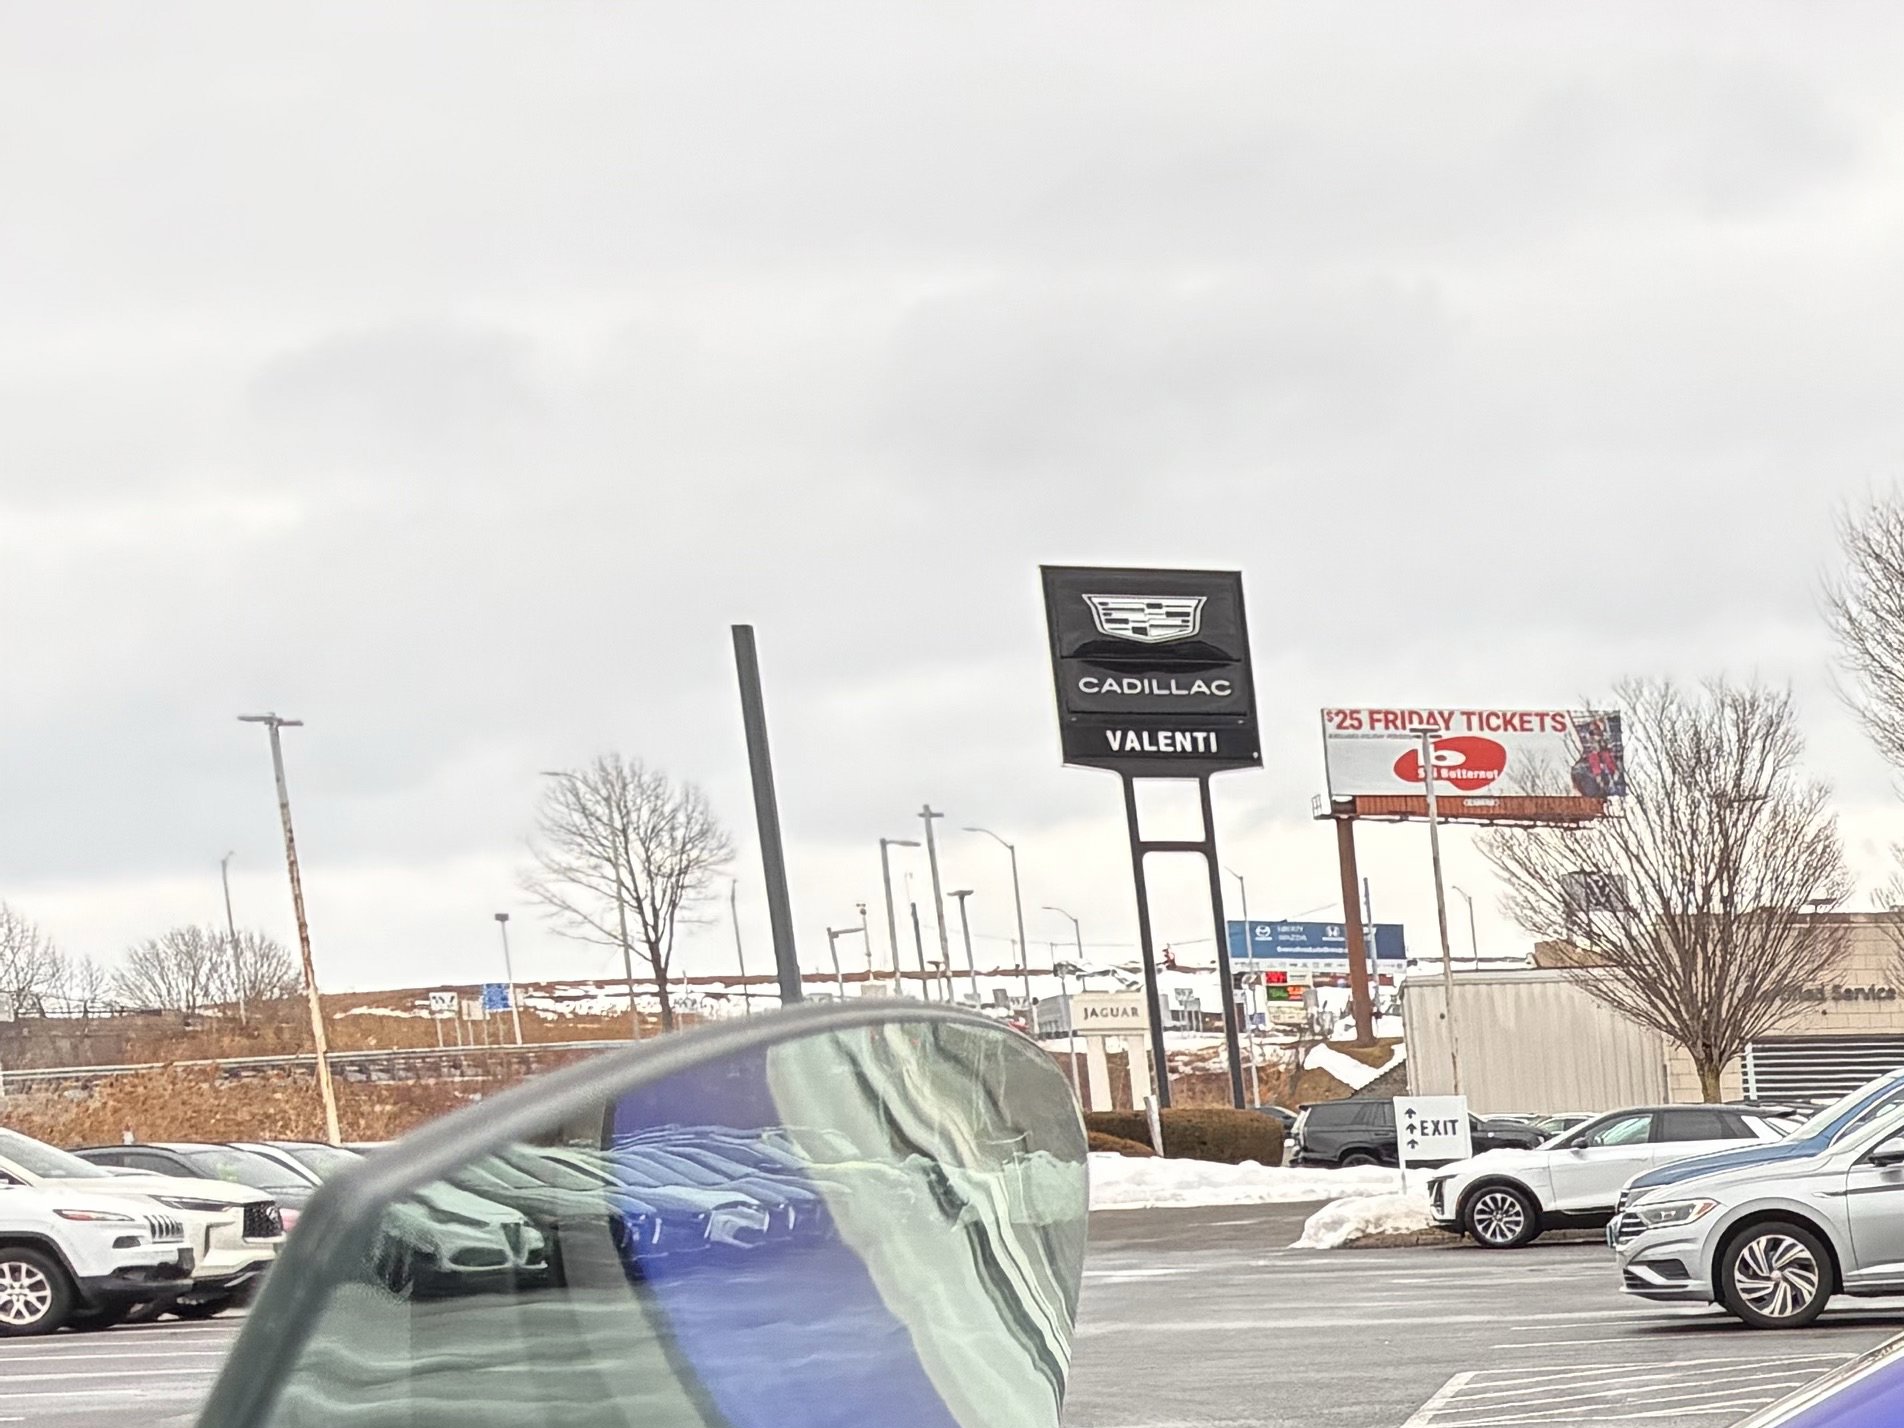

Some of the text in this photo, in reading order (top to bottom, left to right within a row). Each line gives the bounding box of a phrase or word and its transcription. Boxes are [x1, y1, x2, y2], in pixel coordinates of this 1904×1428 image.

[1078, 677, 1232, 696] CADILLAC
[1326, 710, 1568, 732] $25 FRIDAY TICKETS
[1106, 730, 1218, 753] VALENTI
[1418, 768, 1499, 779] Si Butternut
[1832, 984, 1897, 1001] Service
[1083, 1007, 1140, 1020] JAGUAR
[1420, 1120, 1459, 1136] EXIT
